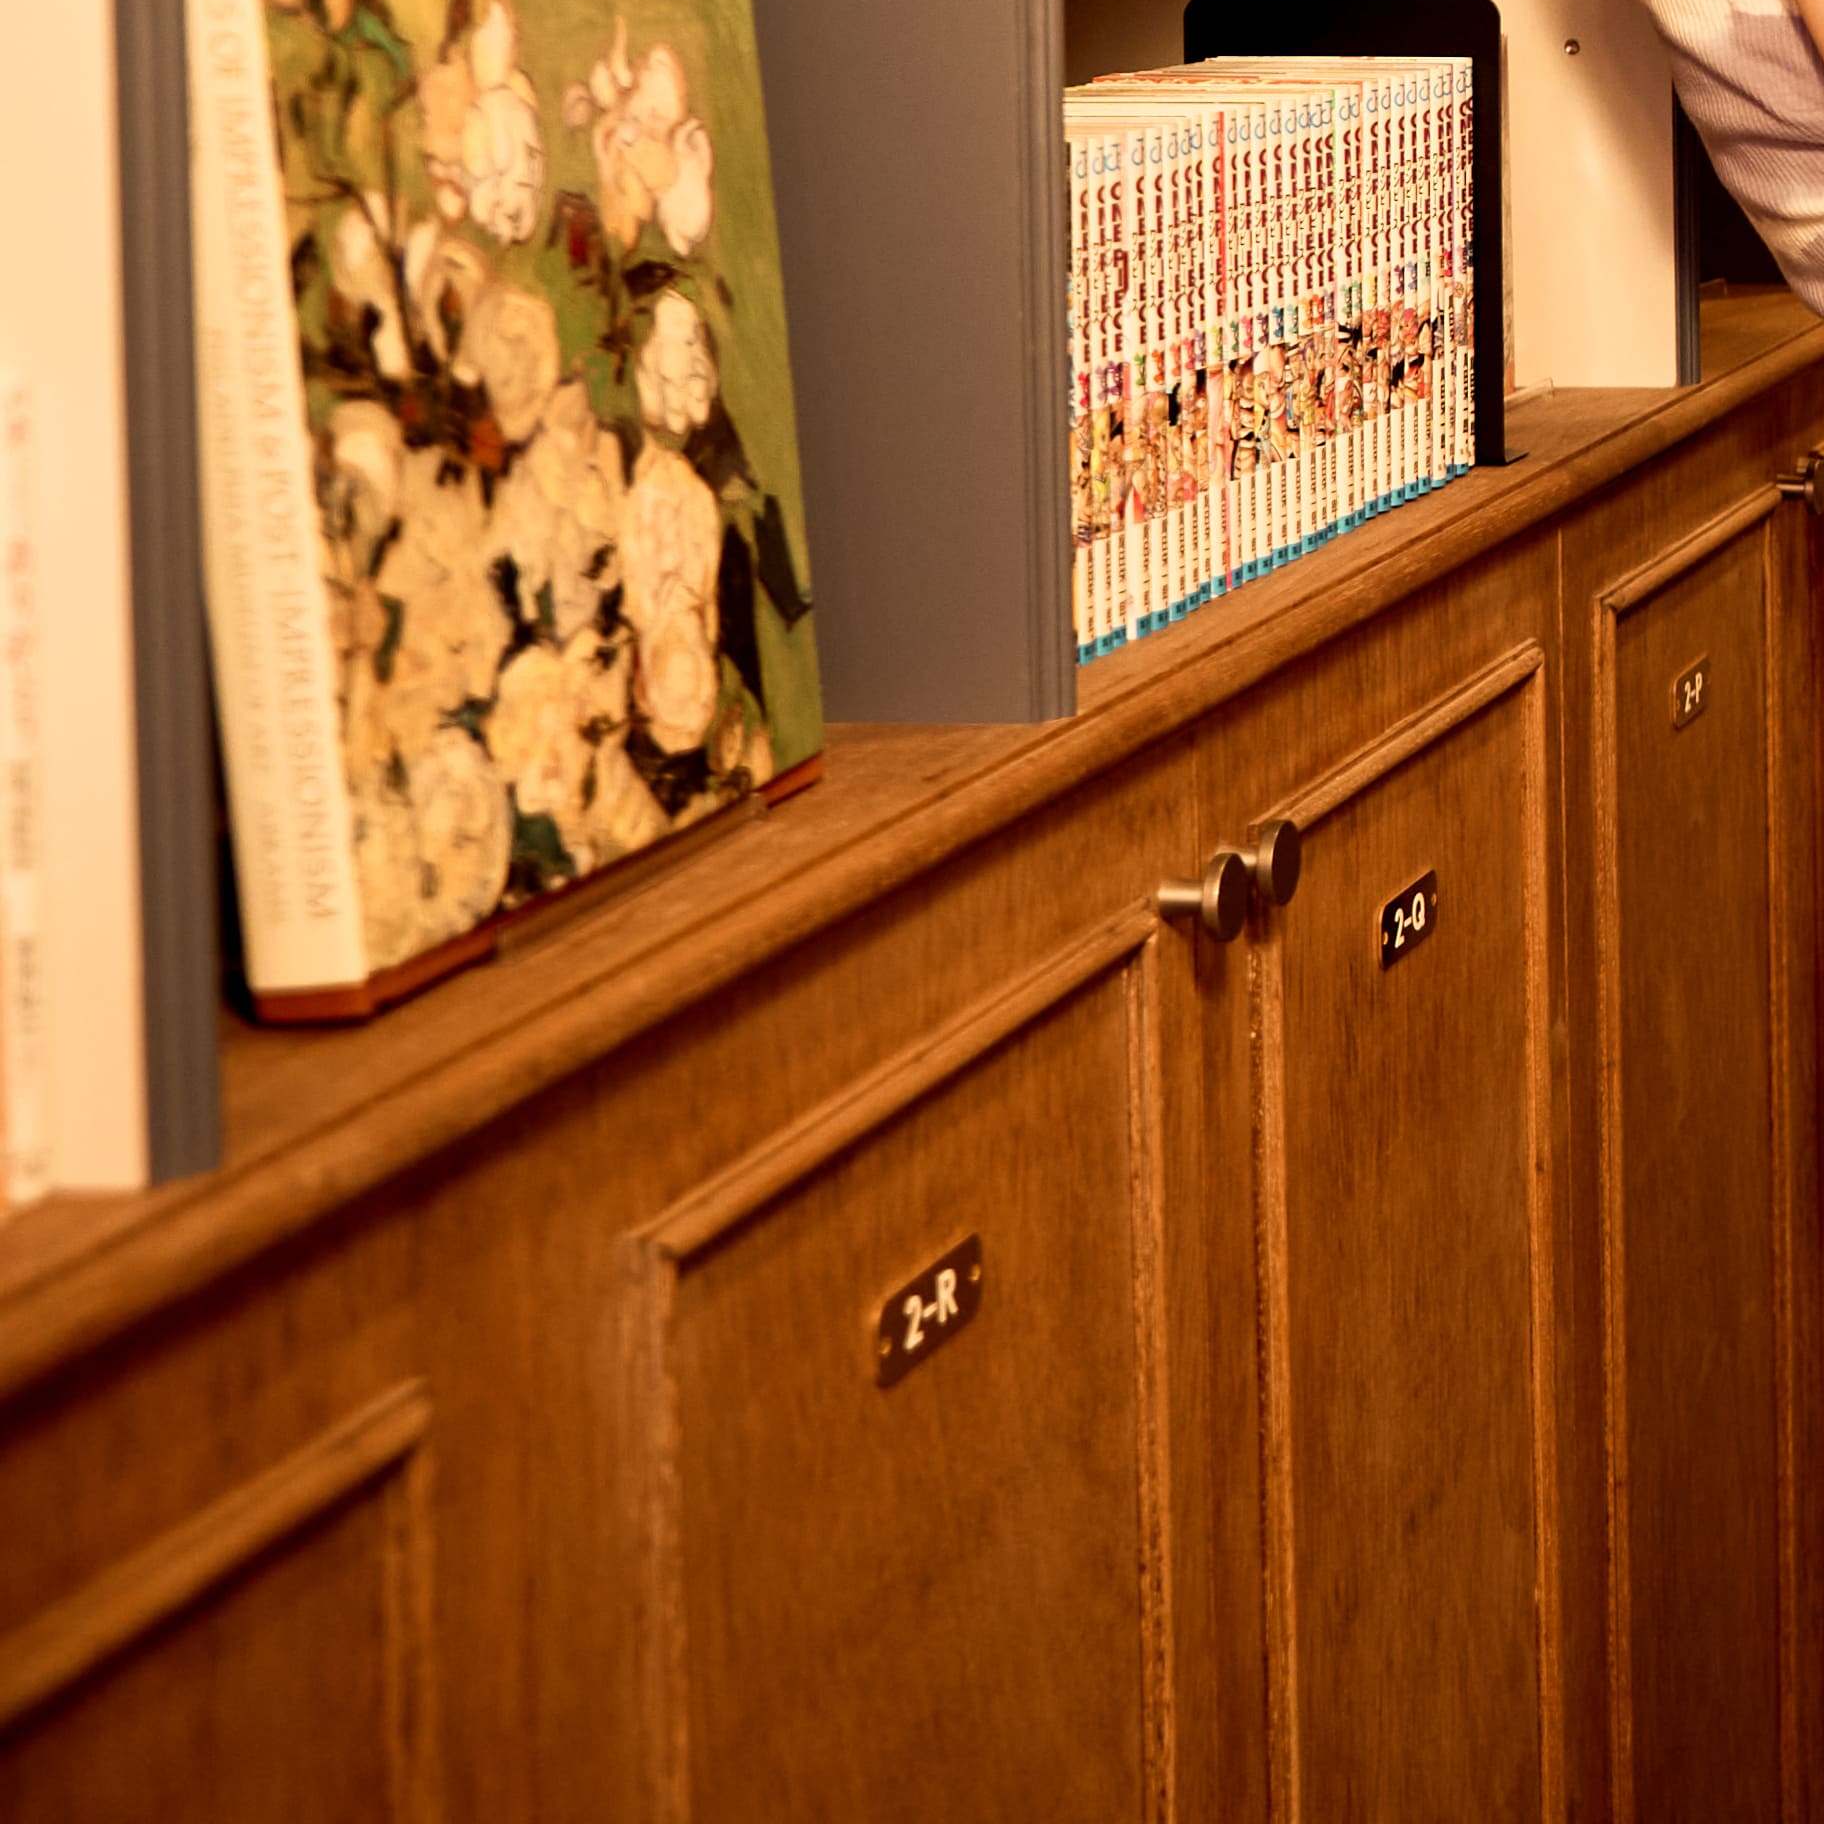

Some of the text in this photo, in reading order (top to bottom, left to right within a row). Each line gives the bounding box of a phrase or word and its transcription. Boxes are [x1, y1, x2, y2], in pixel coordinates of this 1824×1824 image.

[209, 28, 243, 77] OF
[217, 94, 289, 419] IMPRESSIONISM
[1683, 671, 1703, 714] 2-P
[1392, 891, 1427, 949] 2-Q
[902, 1266, 960, 1350] 2-R
